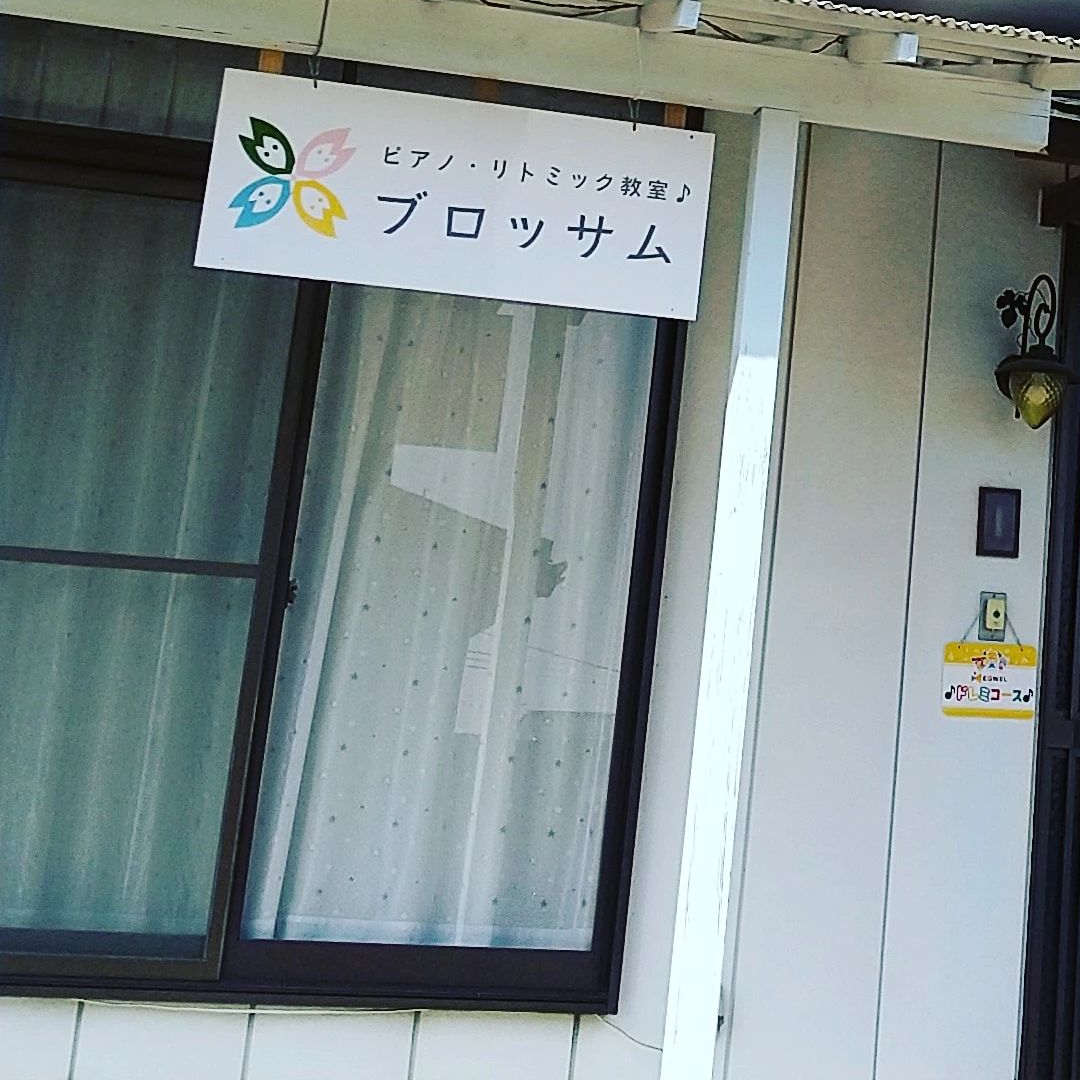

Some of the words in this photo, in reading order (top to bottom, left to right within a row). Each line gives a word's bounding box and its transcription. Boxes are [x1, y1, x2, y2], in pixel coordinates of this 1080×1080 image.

[376, 191, 672, 264] ブロッサム
